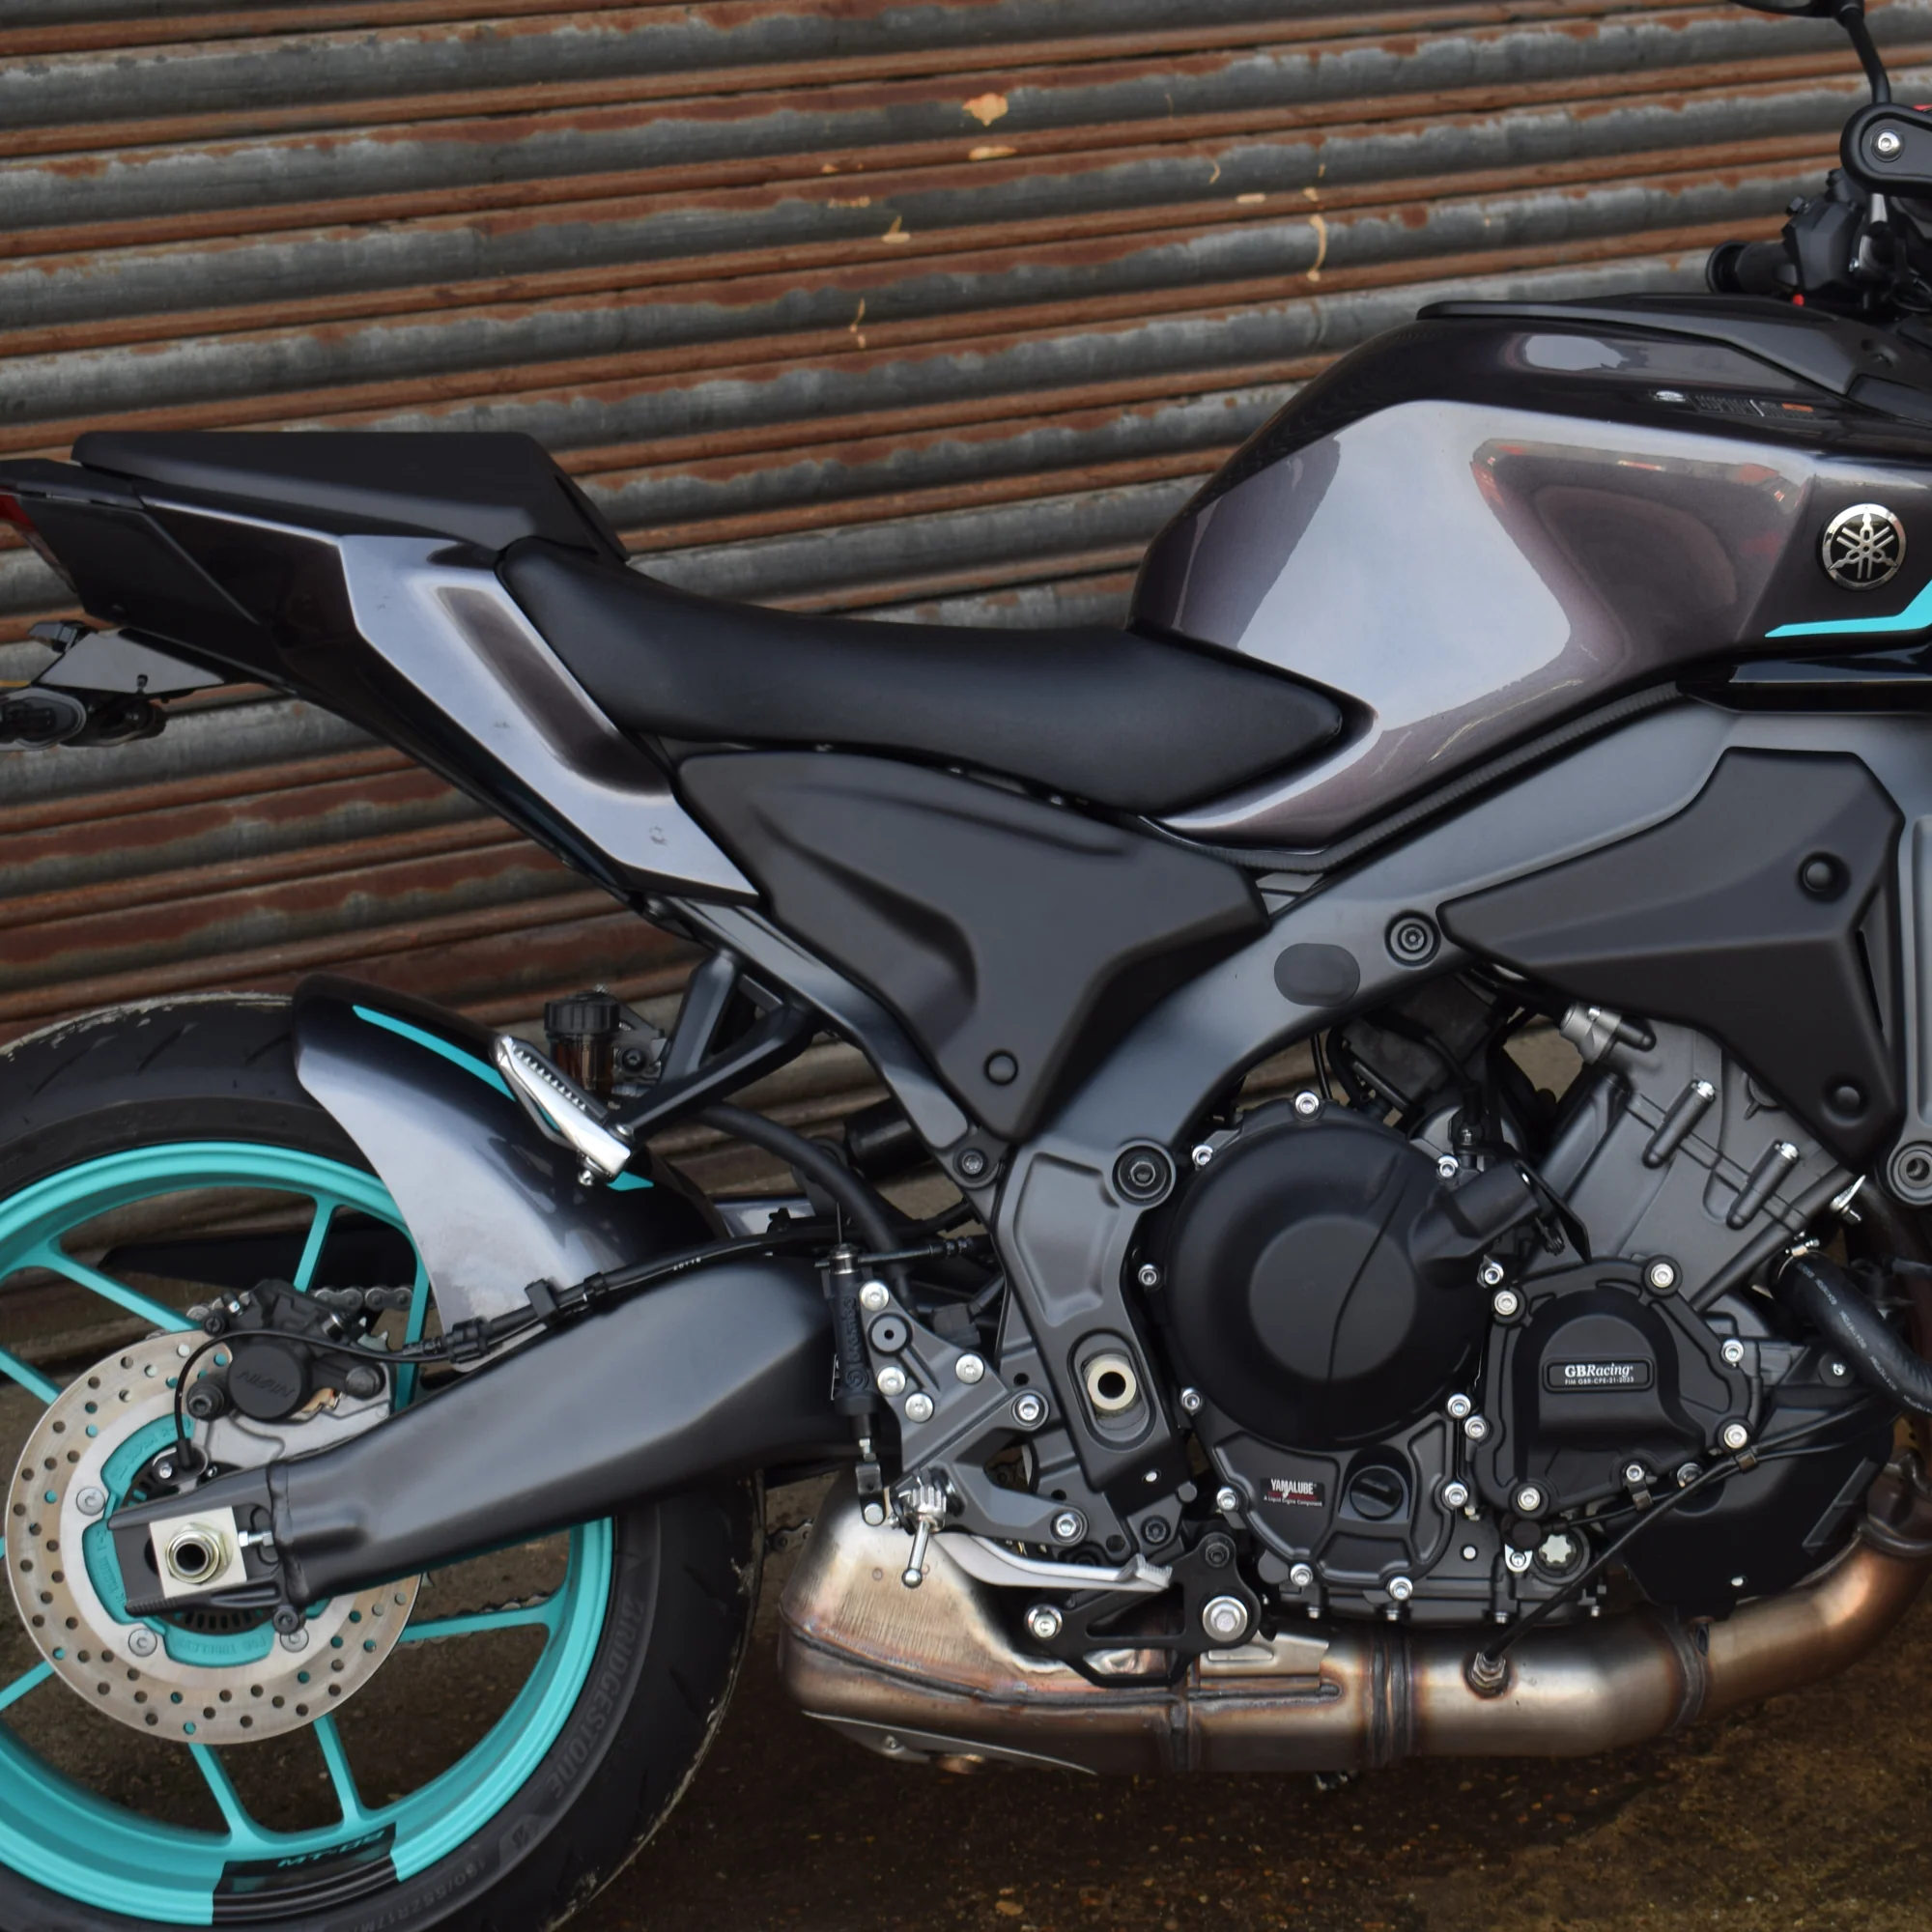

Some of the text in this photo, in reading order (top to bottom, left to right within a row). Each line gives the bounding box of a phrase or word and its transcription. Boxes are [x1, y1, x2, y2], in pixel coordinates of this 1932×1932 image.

[1565, 1363, 1632, 1378] GBRacing
[1271, 1477, 1314, 1496] YAMALUBE
[546, 1595, 644, 1799] BRIDGESTONE
